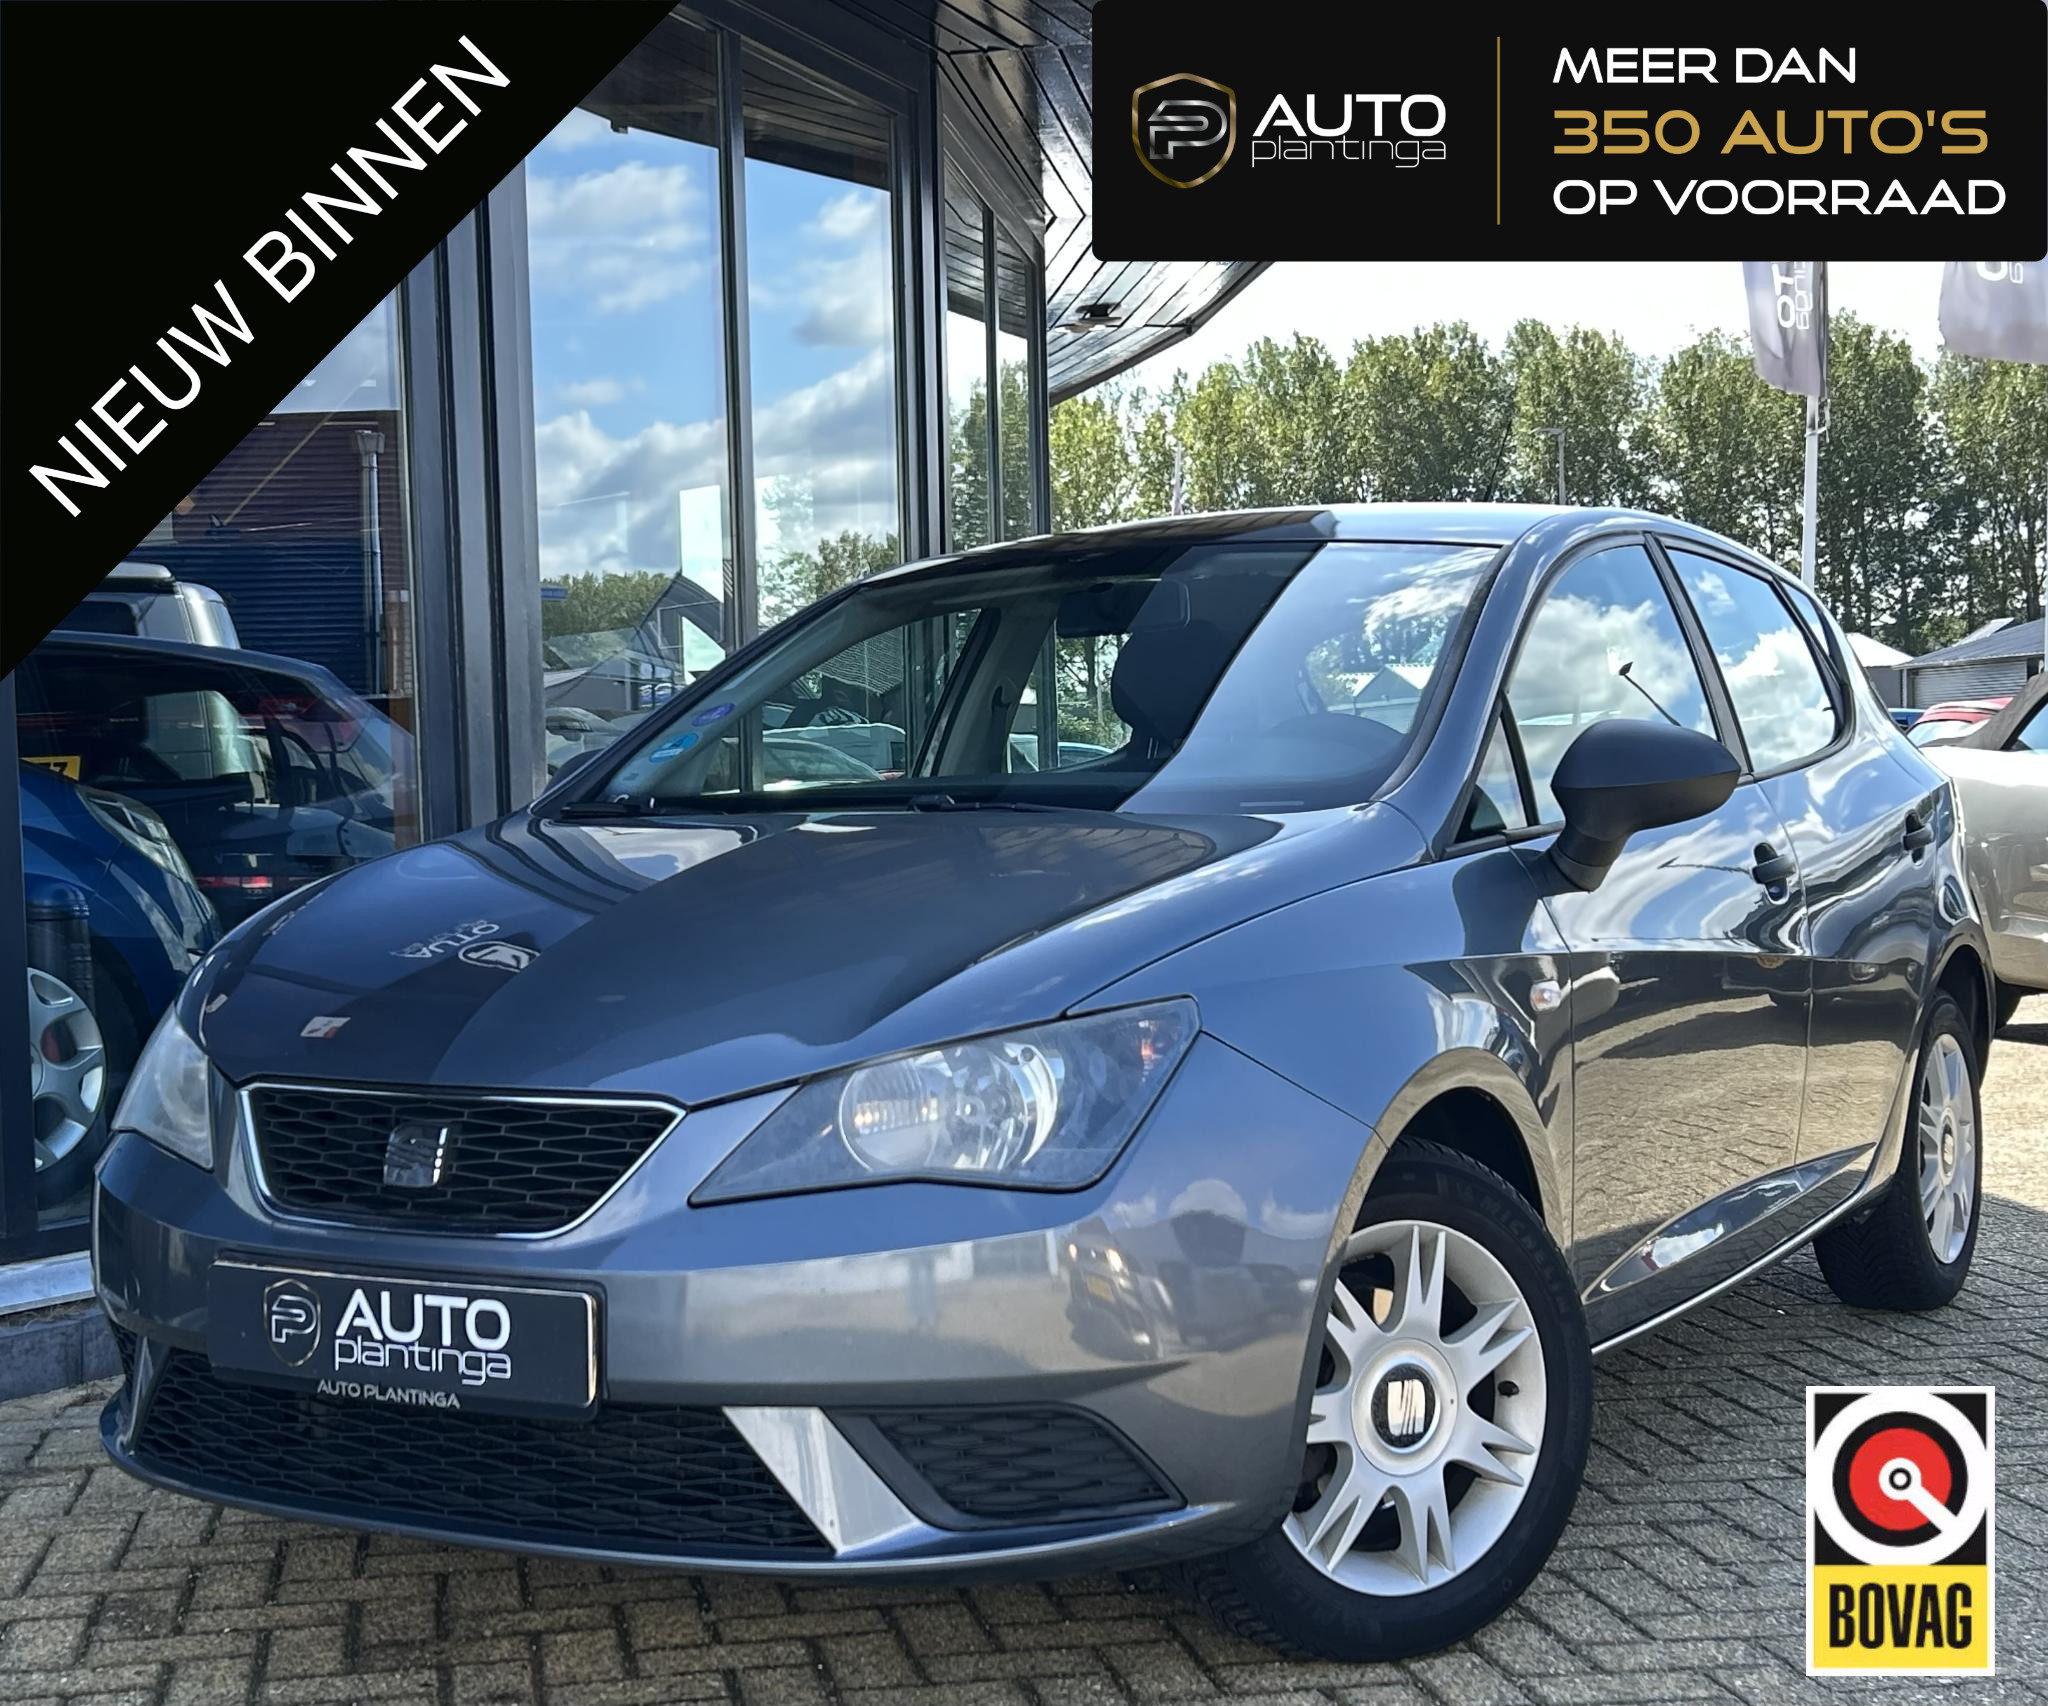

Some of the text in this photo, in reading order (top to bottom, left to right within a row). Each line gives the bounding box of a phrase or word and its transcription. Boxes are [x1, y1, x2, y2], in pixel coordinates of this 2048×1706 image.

[335, 1288, 512, 1351] AUTO
[334, 1335, 512, 1386] plantinga
[317, 1378, 461, 1410] AUTO PLANTINGA
